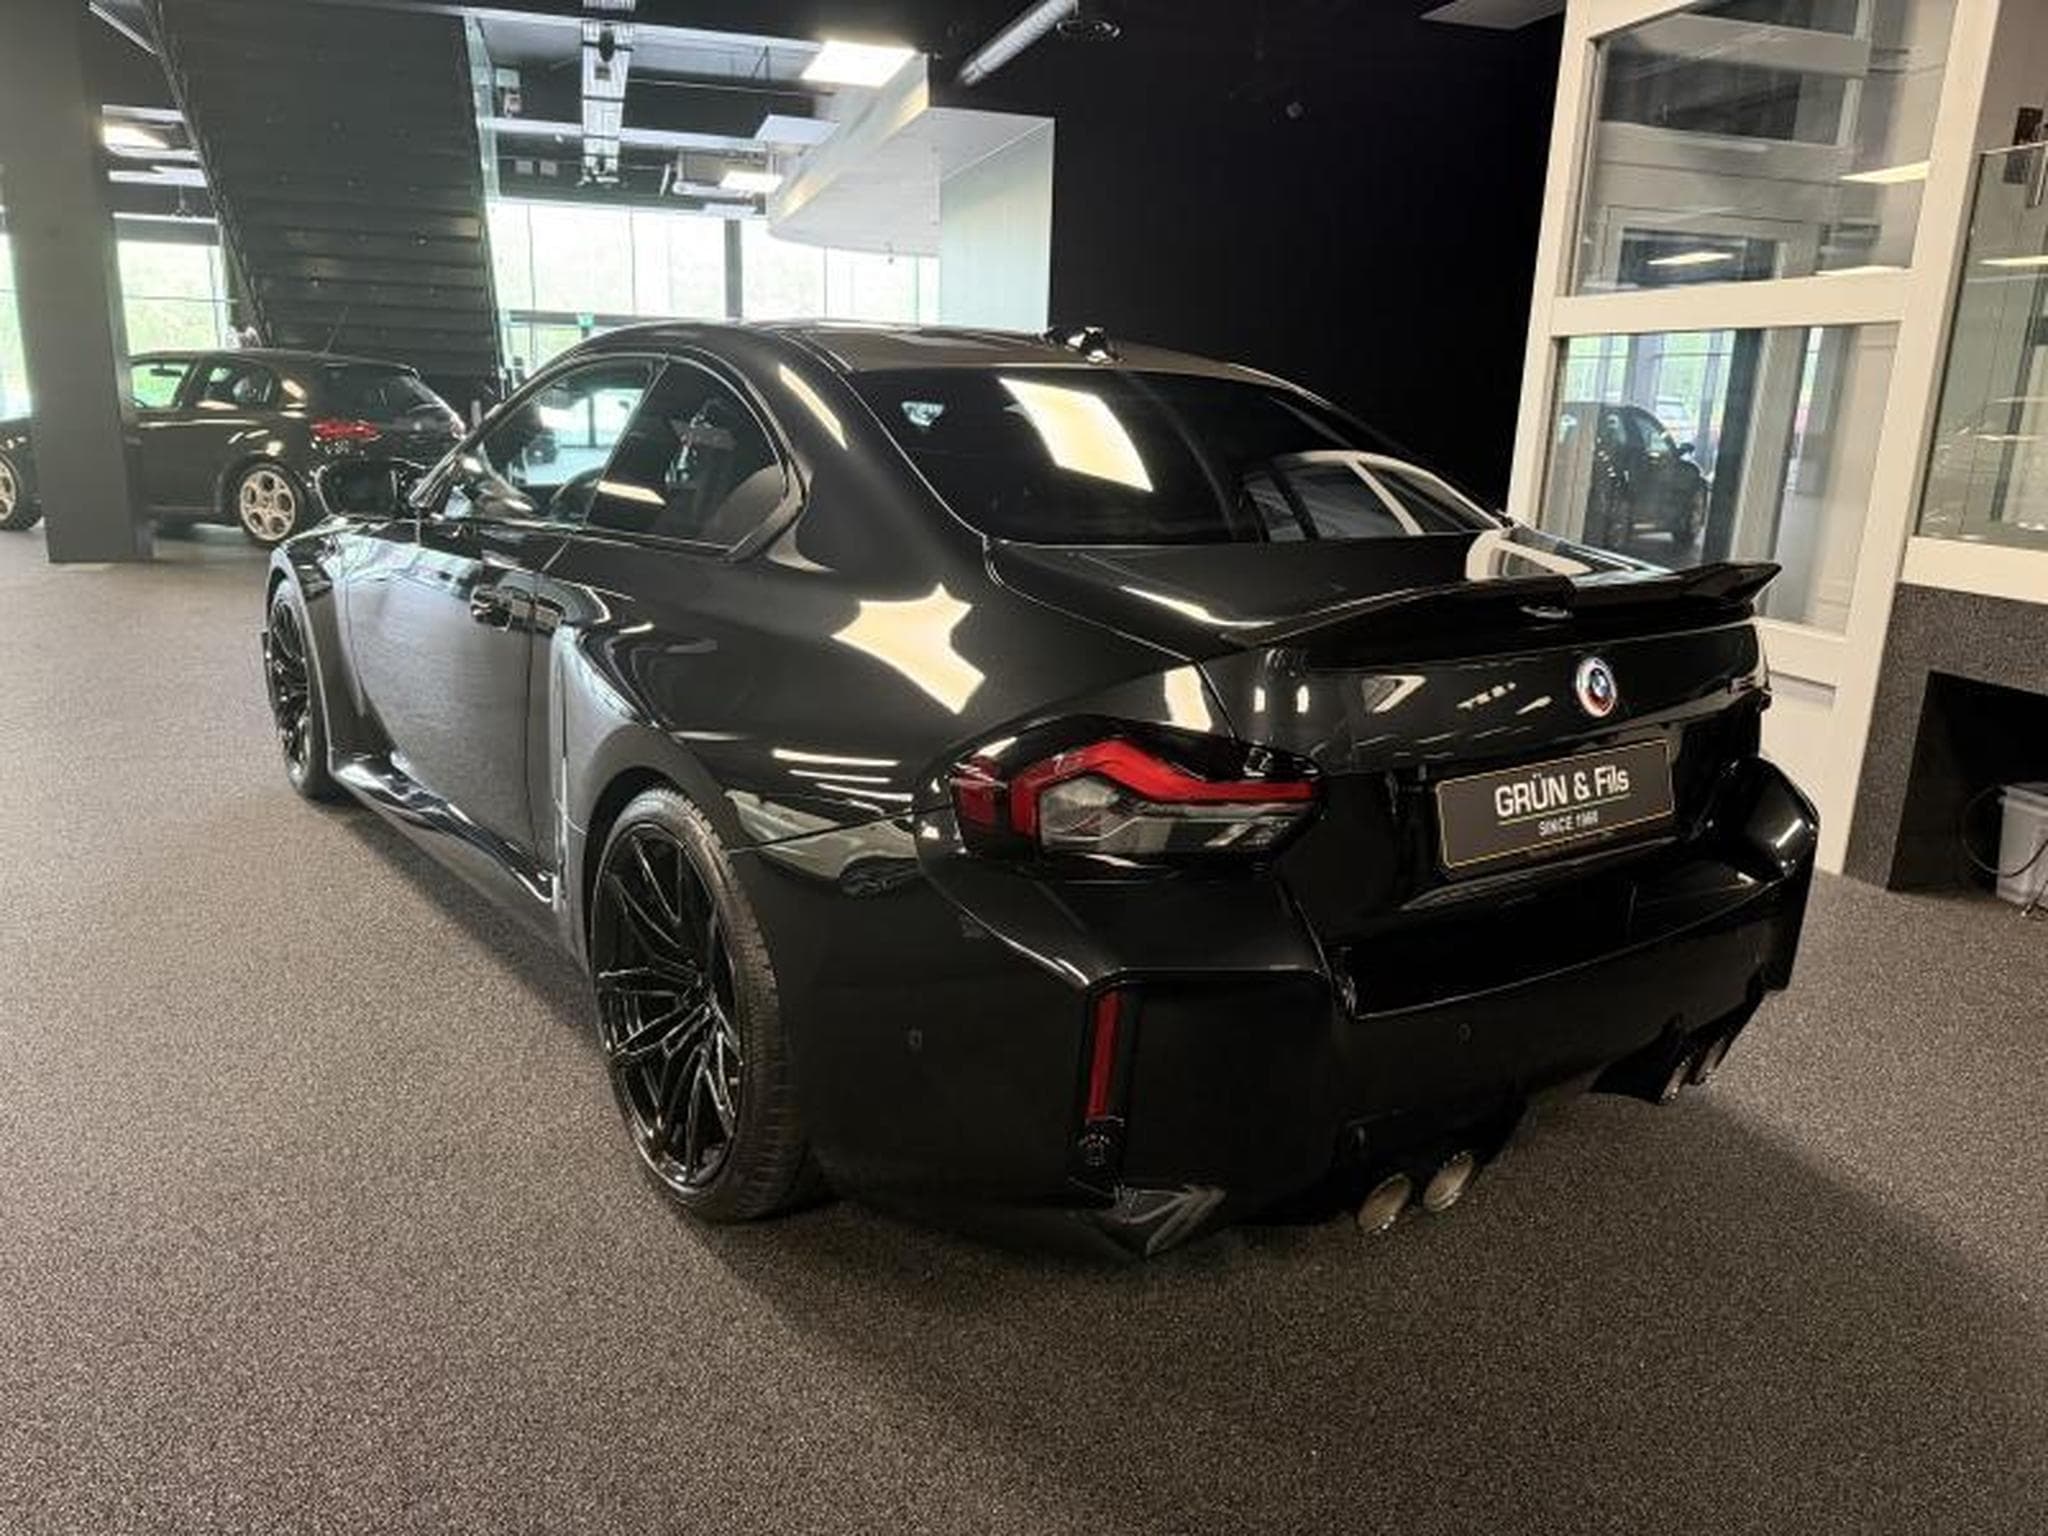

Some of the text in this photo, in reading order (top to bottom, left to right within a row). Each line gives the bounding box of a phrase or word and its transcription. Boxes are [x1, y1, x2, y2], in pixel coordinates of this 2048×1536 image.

[1494, 765, 1629, 817] GRÜN & Fils
[1538, 815, 1574, 837] SINCE
